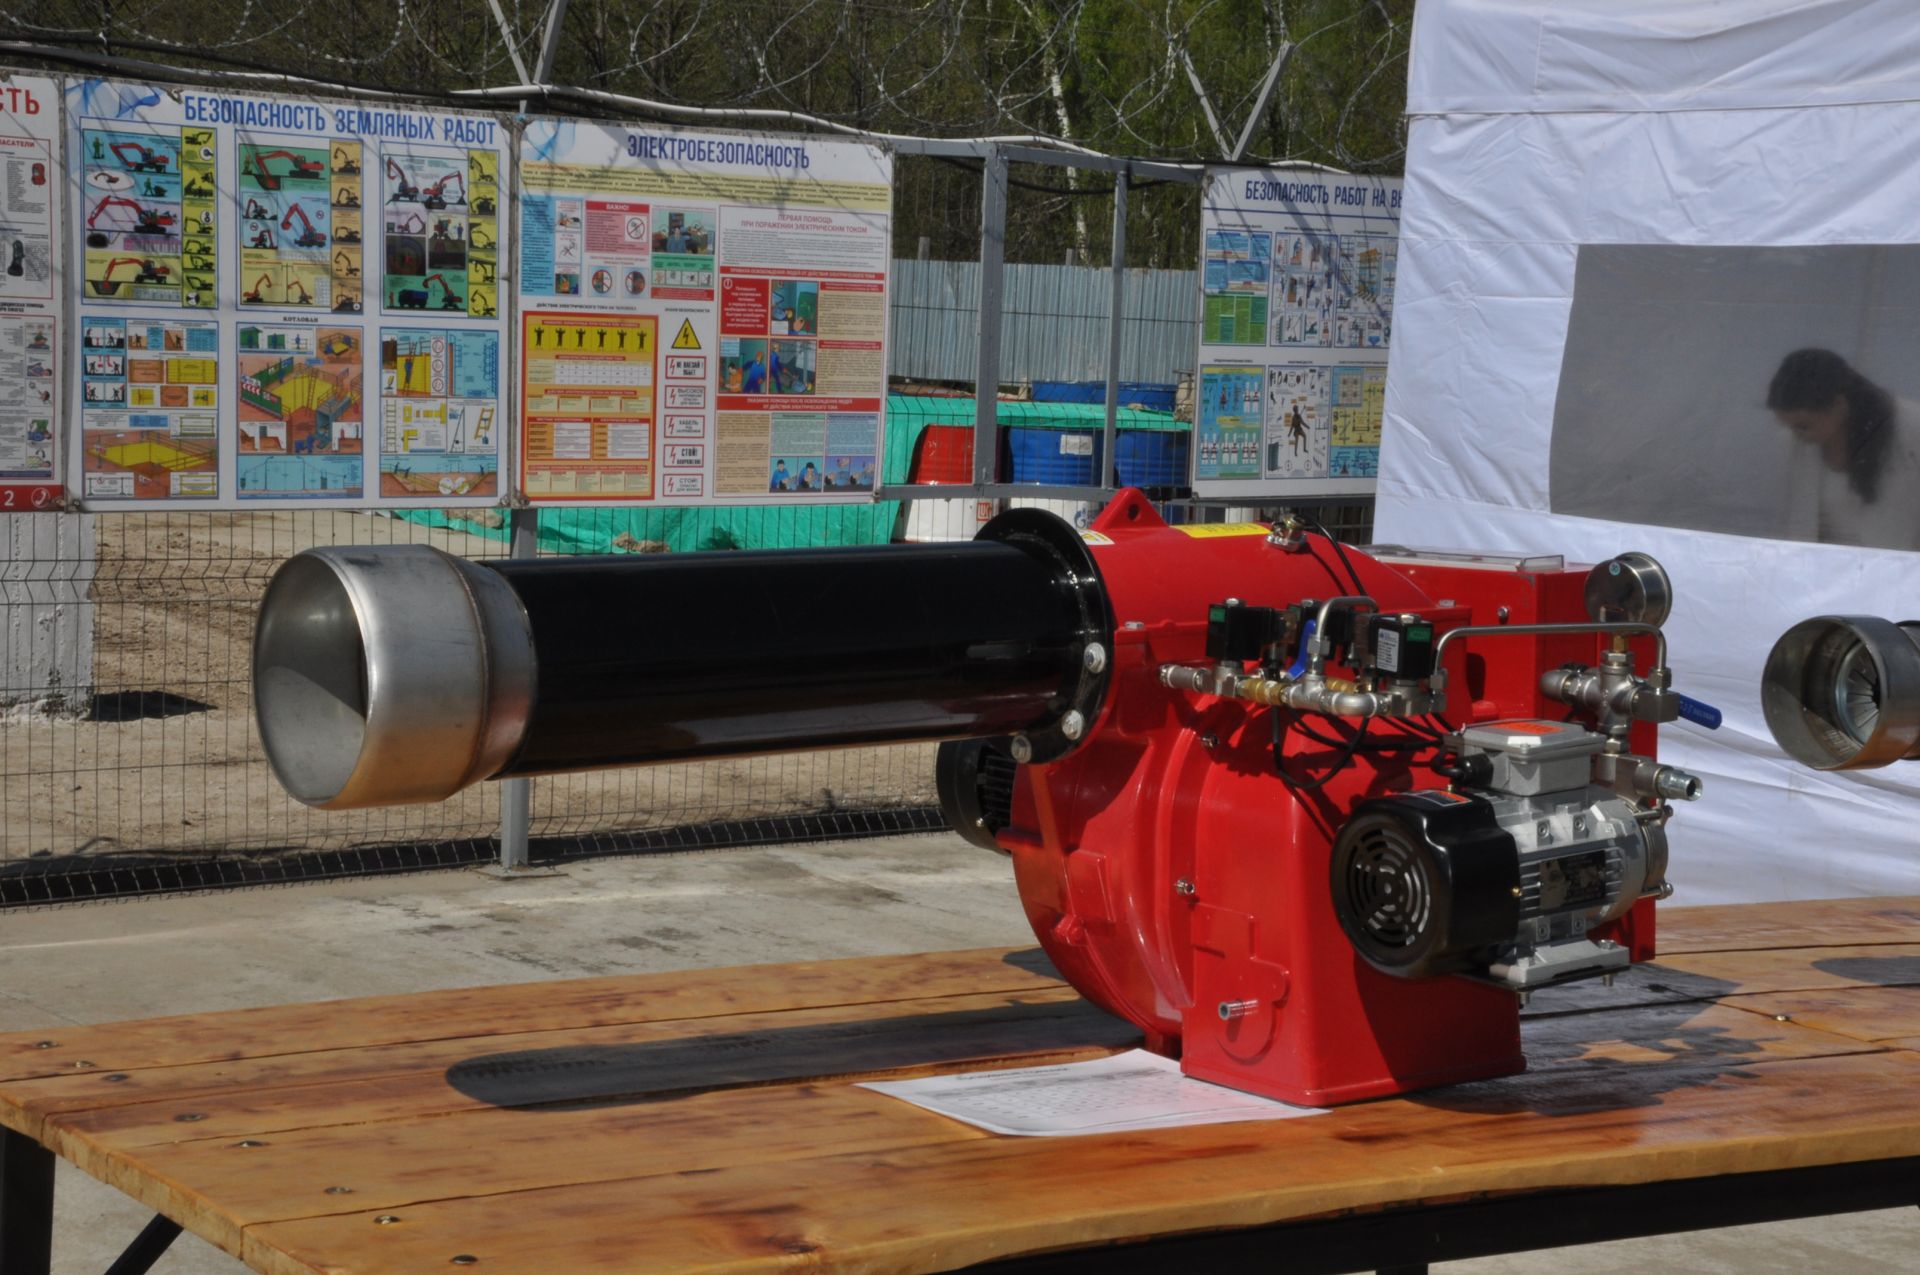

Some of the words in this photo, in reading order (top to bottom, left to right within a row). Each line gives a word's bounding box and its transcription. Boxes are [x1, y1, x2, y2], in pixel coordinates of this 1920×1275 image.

[184, 95, 326, 132] БЕЗОПАСНОСТЬ
[335, 108, 435, 140] ЗЕМЛЯНЫХ
[443, 118, 497, 145] РАБОТ
[627, 134, 810, 169] ЭЛЕКТРОБЕЗОПАСНОСТЬ
[1245, 180, 1329, 204] БЕЗОПАСНОСТЬ
[1334, 186, 1368, 206] РАБОТ
[1372, 188, 1386, 208] НА
[778, 213, 802, 222] ПЕРВАЯ
[803, 215, 833, 225] ПОМОЩЬ
[846, 225, 868, 233] ТОКОМ
